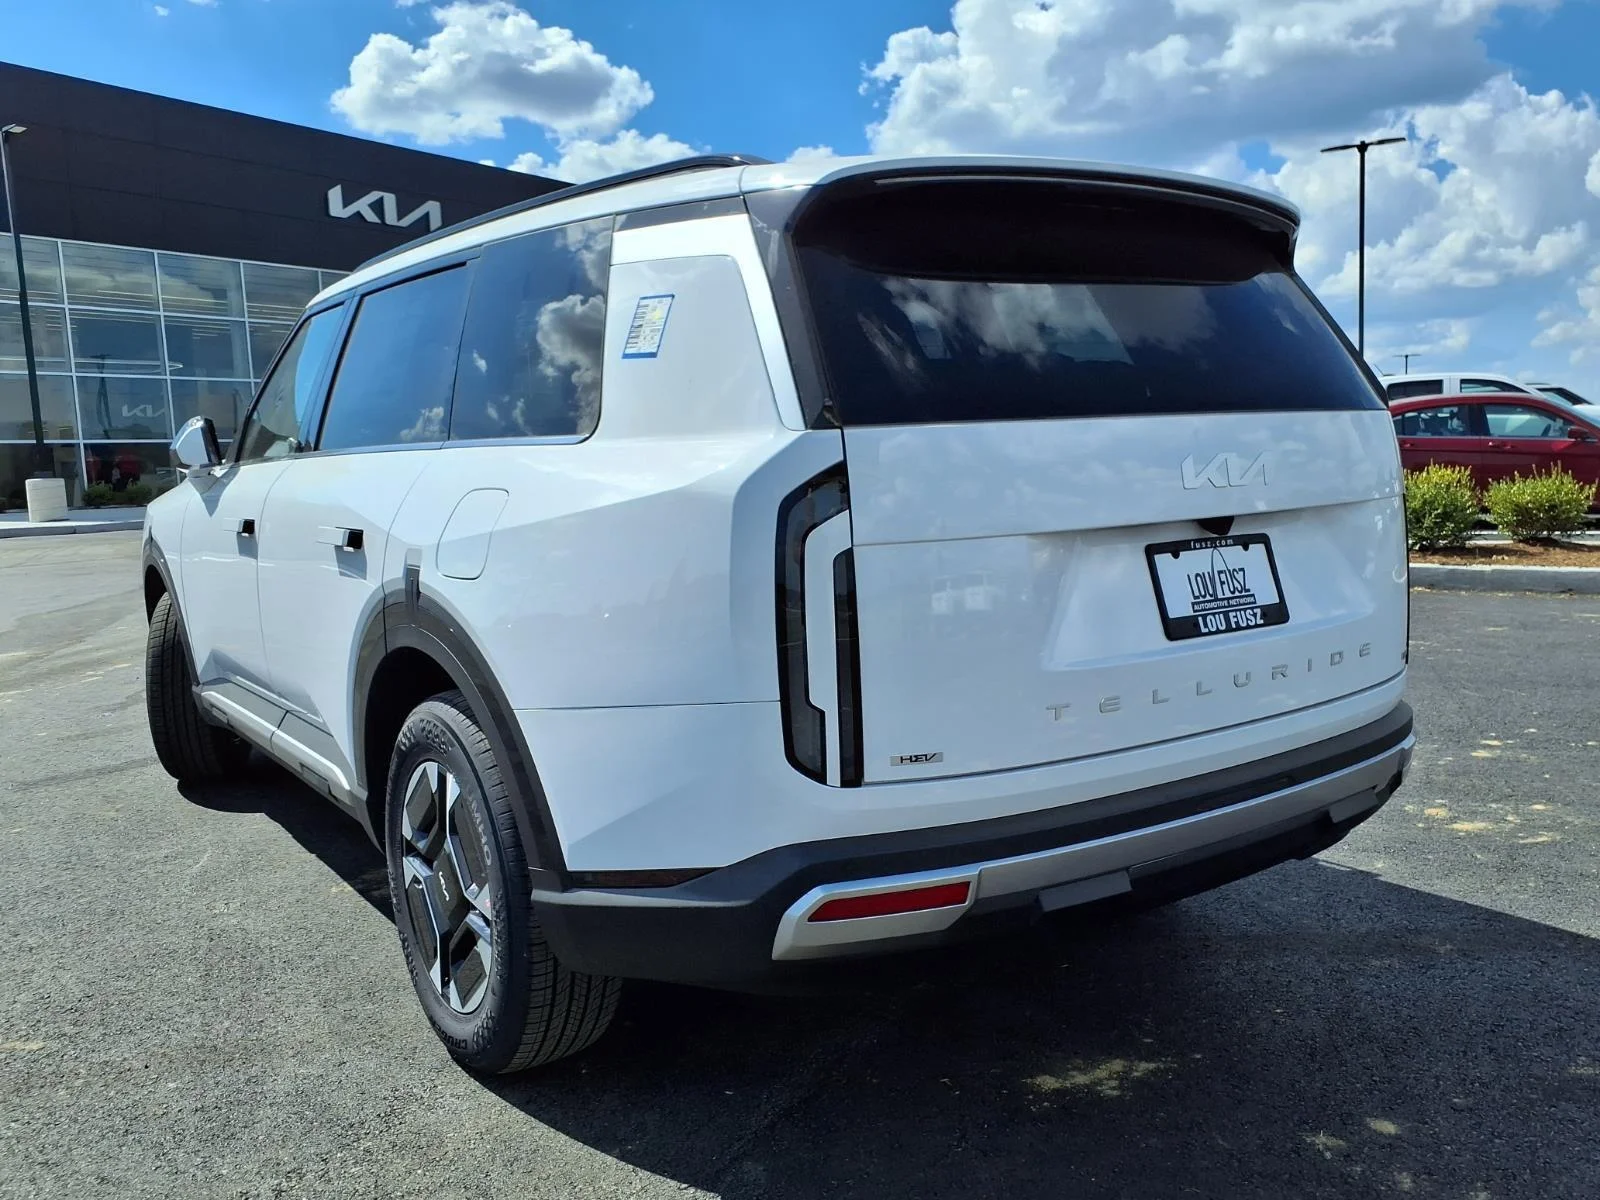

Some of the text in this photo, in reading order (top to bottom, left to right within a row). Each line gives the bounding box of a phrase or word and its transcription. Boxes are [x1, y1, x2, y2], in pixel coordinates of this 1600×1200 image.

[327, 184, 443, 232] KIA
[1180, 450, 1274, 490] KIA
[1190, 539, 1234, 549] fusz.com
[1187, 567, 1251, 600] LOU FUSZ
[1193, 596, 1256, 611] AUTOMOTIVE NETWORK
[1198, 608, 1264, 633] LOU FUSZ
[1046, 642, 1373, 721] TELLURIDE
[900, 752, 937, 763] HEV
